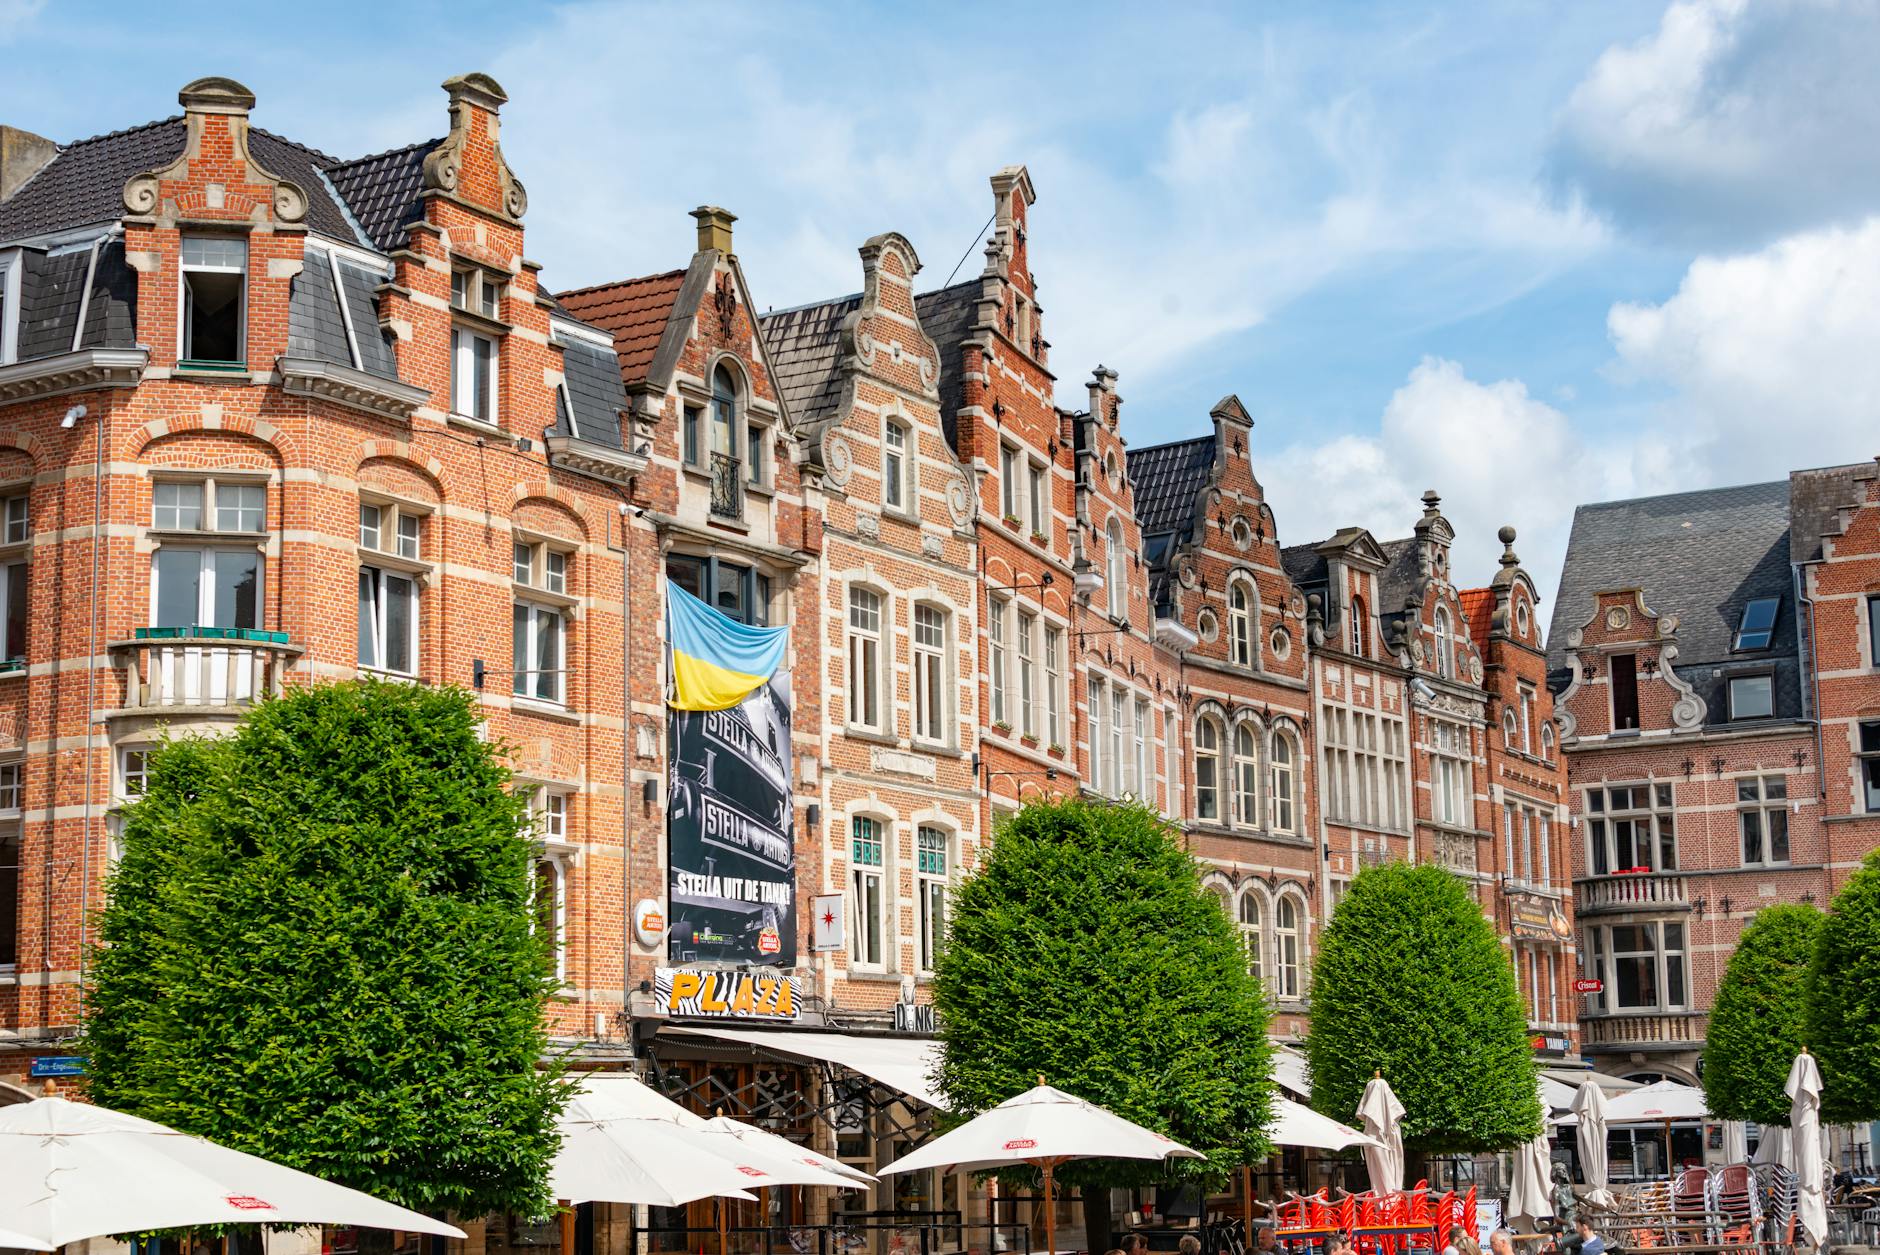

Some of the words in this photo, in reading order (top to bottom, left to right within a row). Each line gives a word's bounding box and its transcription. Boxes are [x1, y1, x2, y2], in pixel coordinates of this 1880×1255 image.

[708, 712, 748, 755] STELLA
[707, 803, 748, 848] STELLA
[853, 820, 870, 838] IT
[853, 839, 881, 864] ERE
[918, 831, 945, 849] AND
[918, 851, 945, 876] ERE
[677, 873, 722, 897] STELLA
[723, 877, 743, 900] UIT
[744, 879, 759, 902] DE
[760, 881, 790, 905] TANK!
[669, 974, 793, 1015] PLAZA
